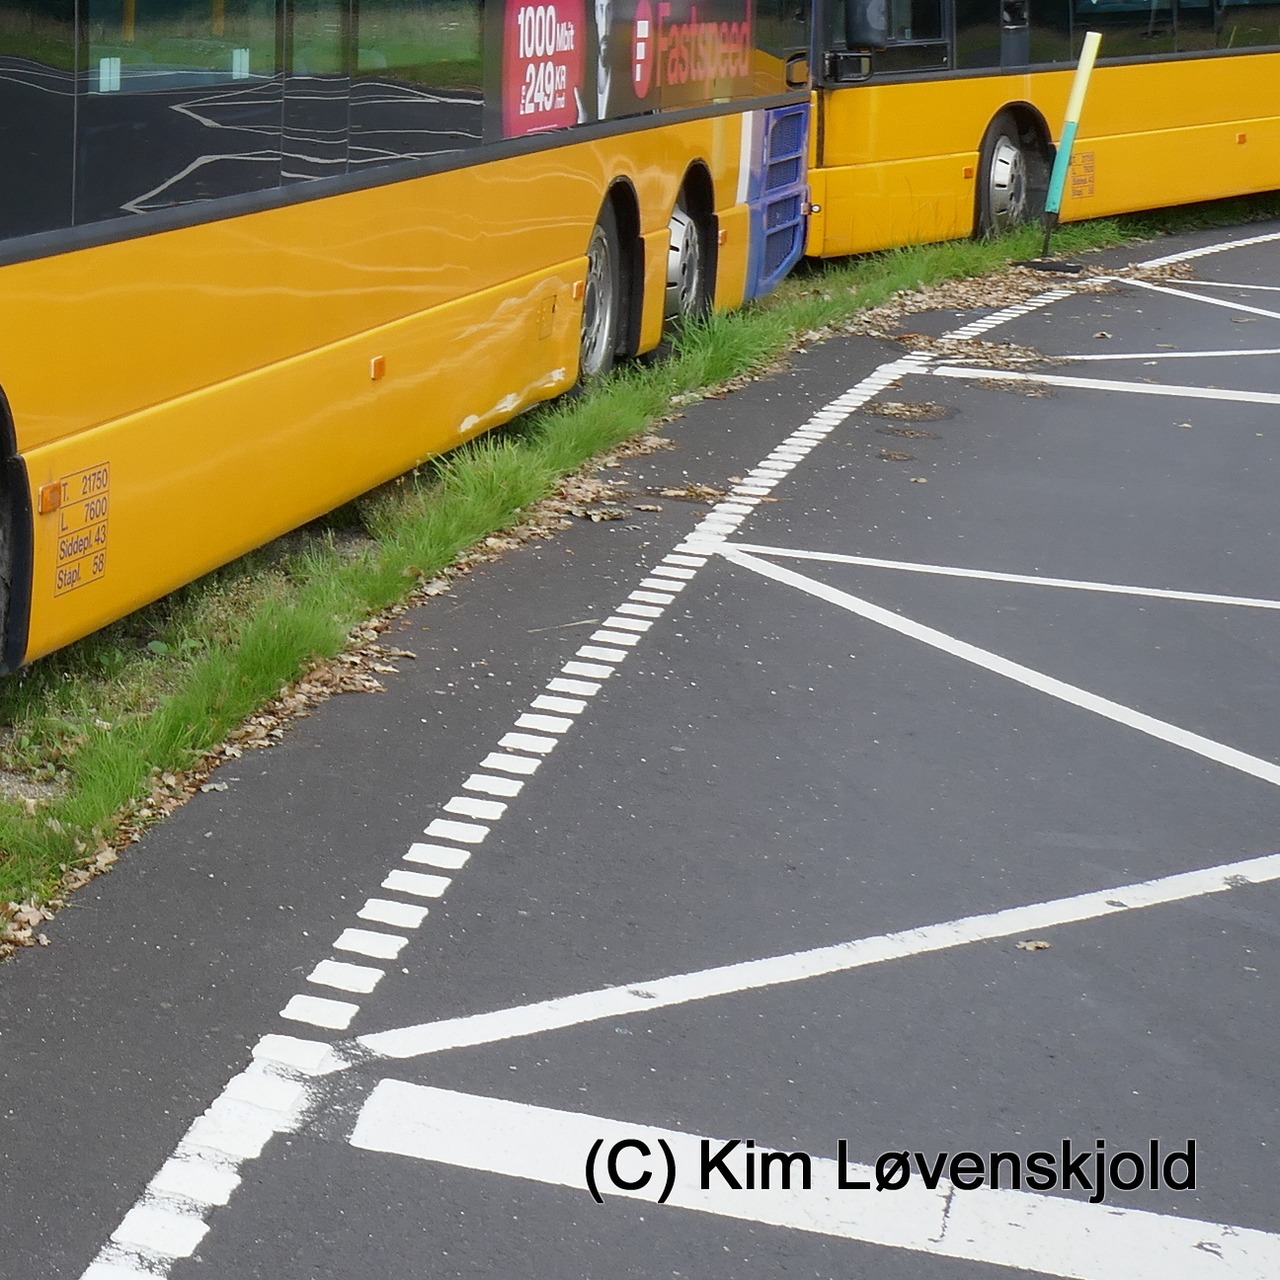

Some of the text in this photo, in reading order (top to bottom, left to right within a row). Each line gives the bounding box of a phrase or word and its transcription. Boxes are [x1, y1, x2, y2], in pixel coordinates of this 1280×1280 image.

[518, 5, 574, 58] 1000 Mbit
[656, 0, 752, 99] Fastspeed
[525, 61, 555, 114] 249
[555, 65, 566, 90] KR
[82, 468, 108, 494] 21750
[84, 496, 108, 522] 7600
[59, 524, 107, 559] Siddepl. 43
